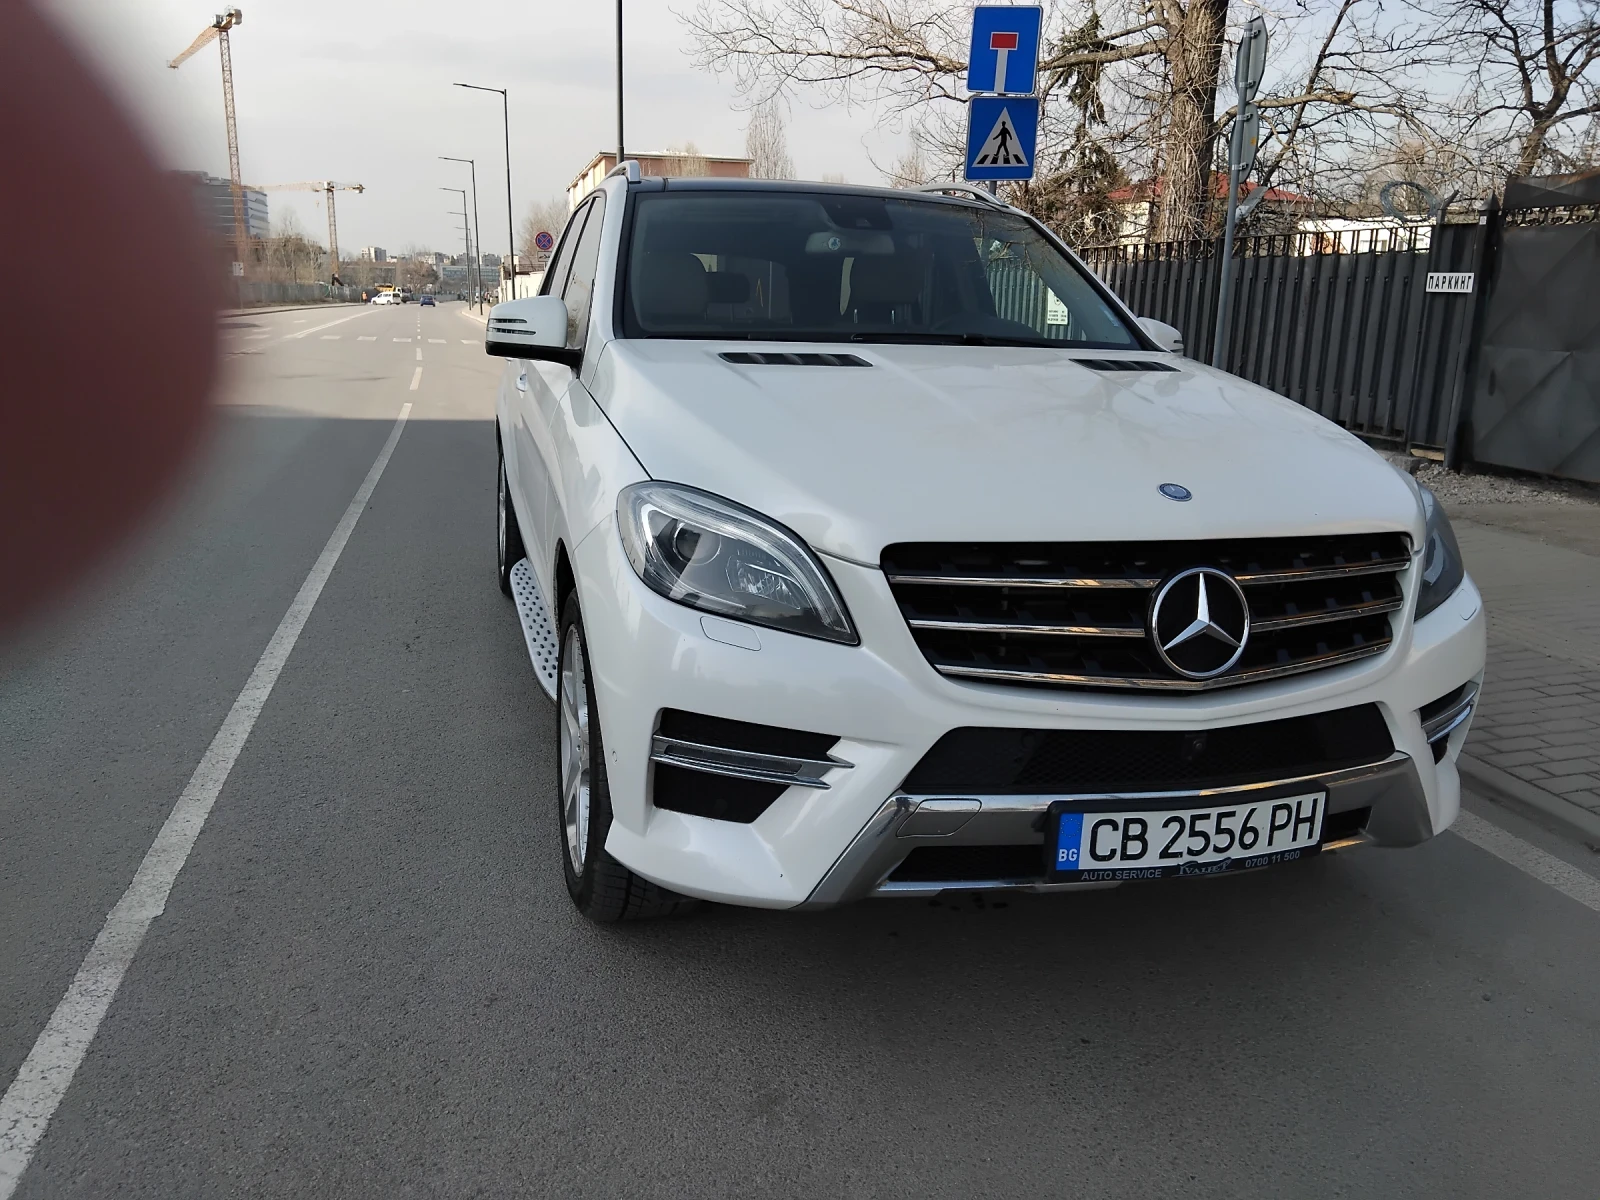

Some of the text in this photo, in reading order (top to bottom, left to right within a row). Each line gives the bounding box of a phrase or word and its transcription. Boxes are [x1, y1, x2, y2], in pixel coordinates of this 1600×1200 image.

[1428, 275, 1472, 290] ПАРКИНГ
[1089, 798, 1318, 862] CB 2556 PH
[1058, 848, 1078, 862] BG
[1081, 870, 1112, 880] AUTO
[1115, 869, 1162, 879] SERVICE
[1245, 856, 1269, 868] 0700
[1271, 854, 1281, 864] 11
[1283, 850, 1301, 861] 500
